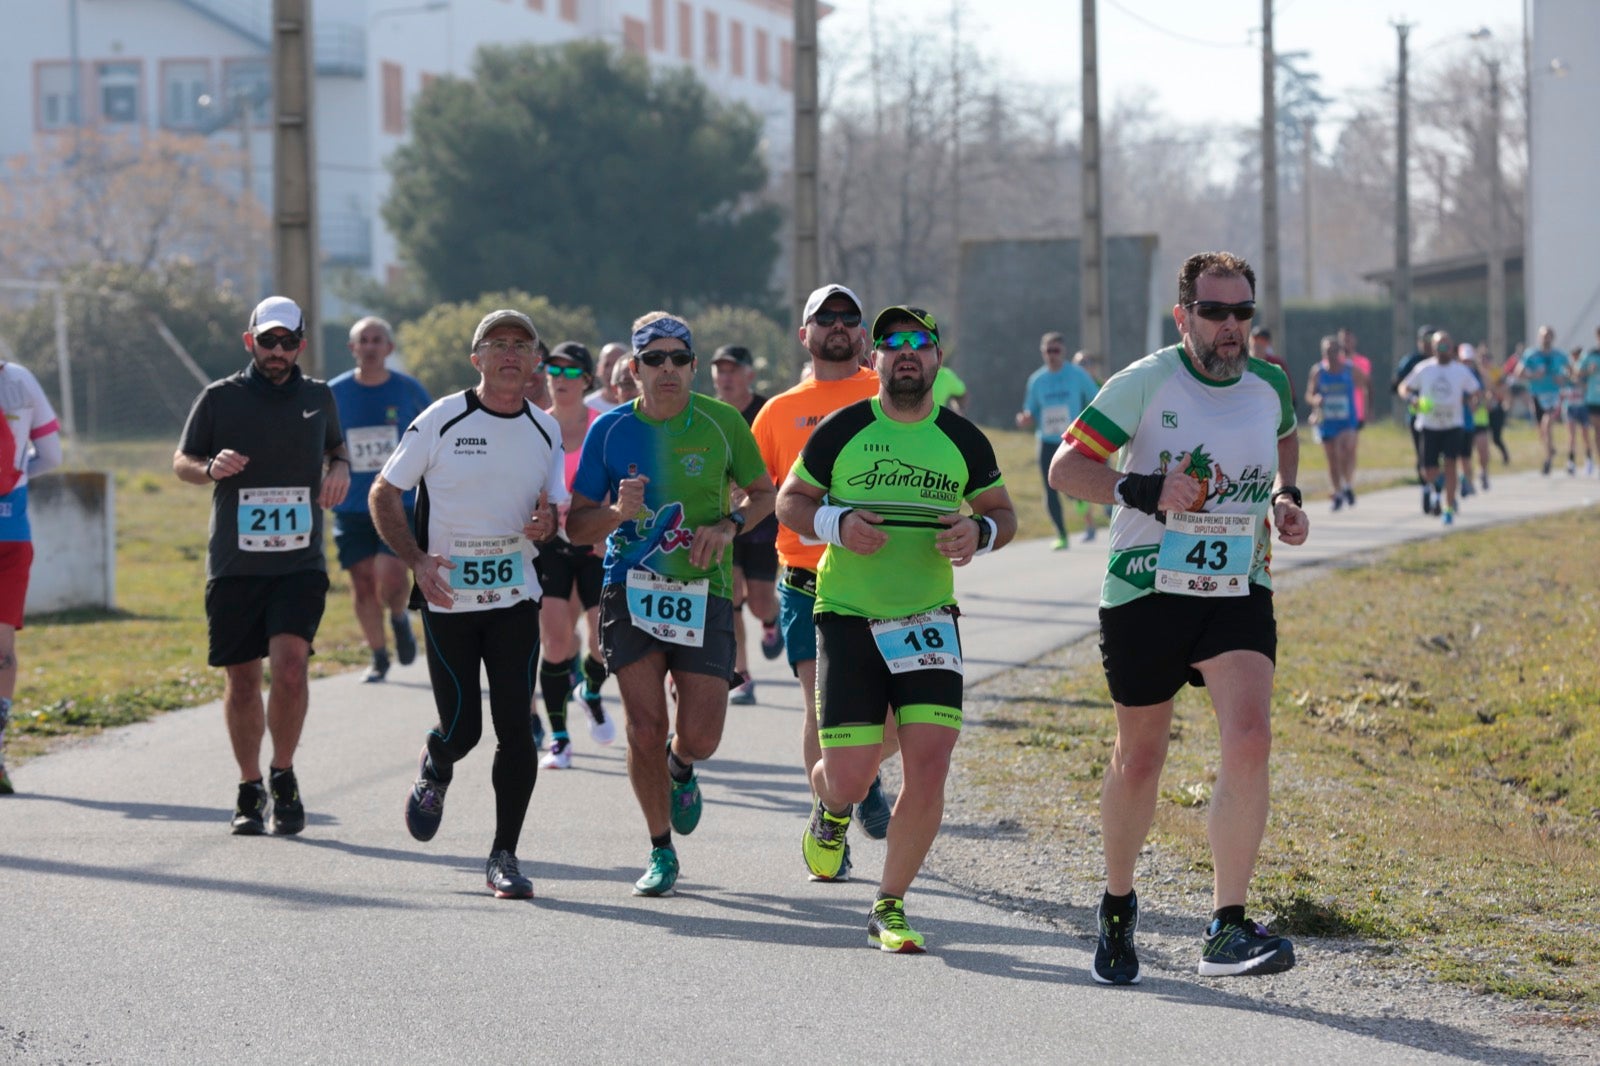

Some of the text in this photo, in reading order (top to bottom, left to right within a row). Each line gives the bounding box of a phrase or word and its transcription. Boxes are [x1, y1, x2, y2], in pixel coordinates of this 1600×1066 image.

[864, 444, 890, 452] GOBIK
[1239, 468, 1259, 481] LA
[251, 508, 296, 531] 211
[1187, 514, 1203, 524] GRAN
[1203, 515, 1223, 525] PREMIO
[1225, 516, 1232, 525] DE
[1232, 516, 1250, 525] FONDO
[1185, 540, 1228, 570] 43
[463, 559, 513, 585] 556
[640, 594, 692, 622] 168
[904, 627, 944, 652] 18
